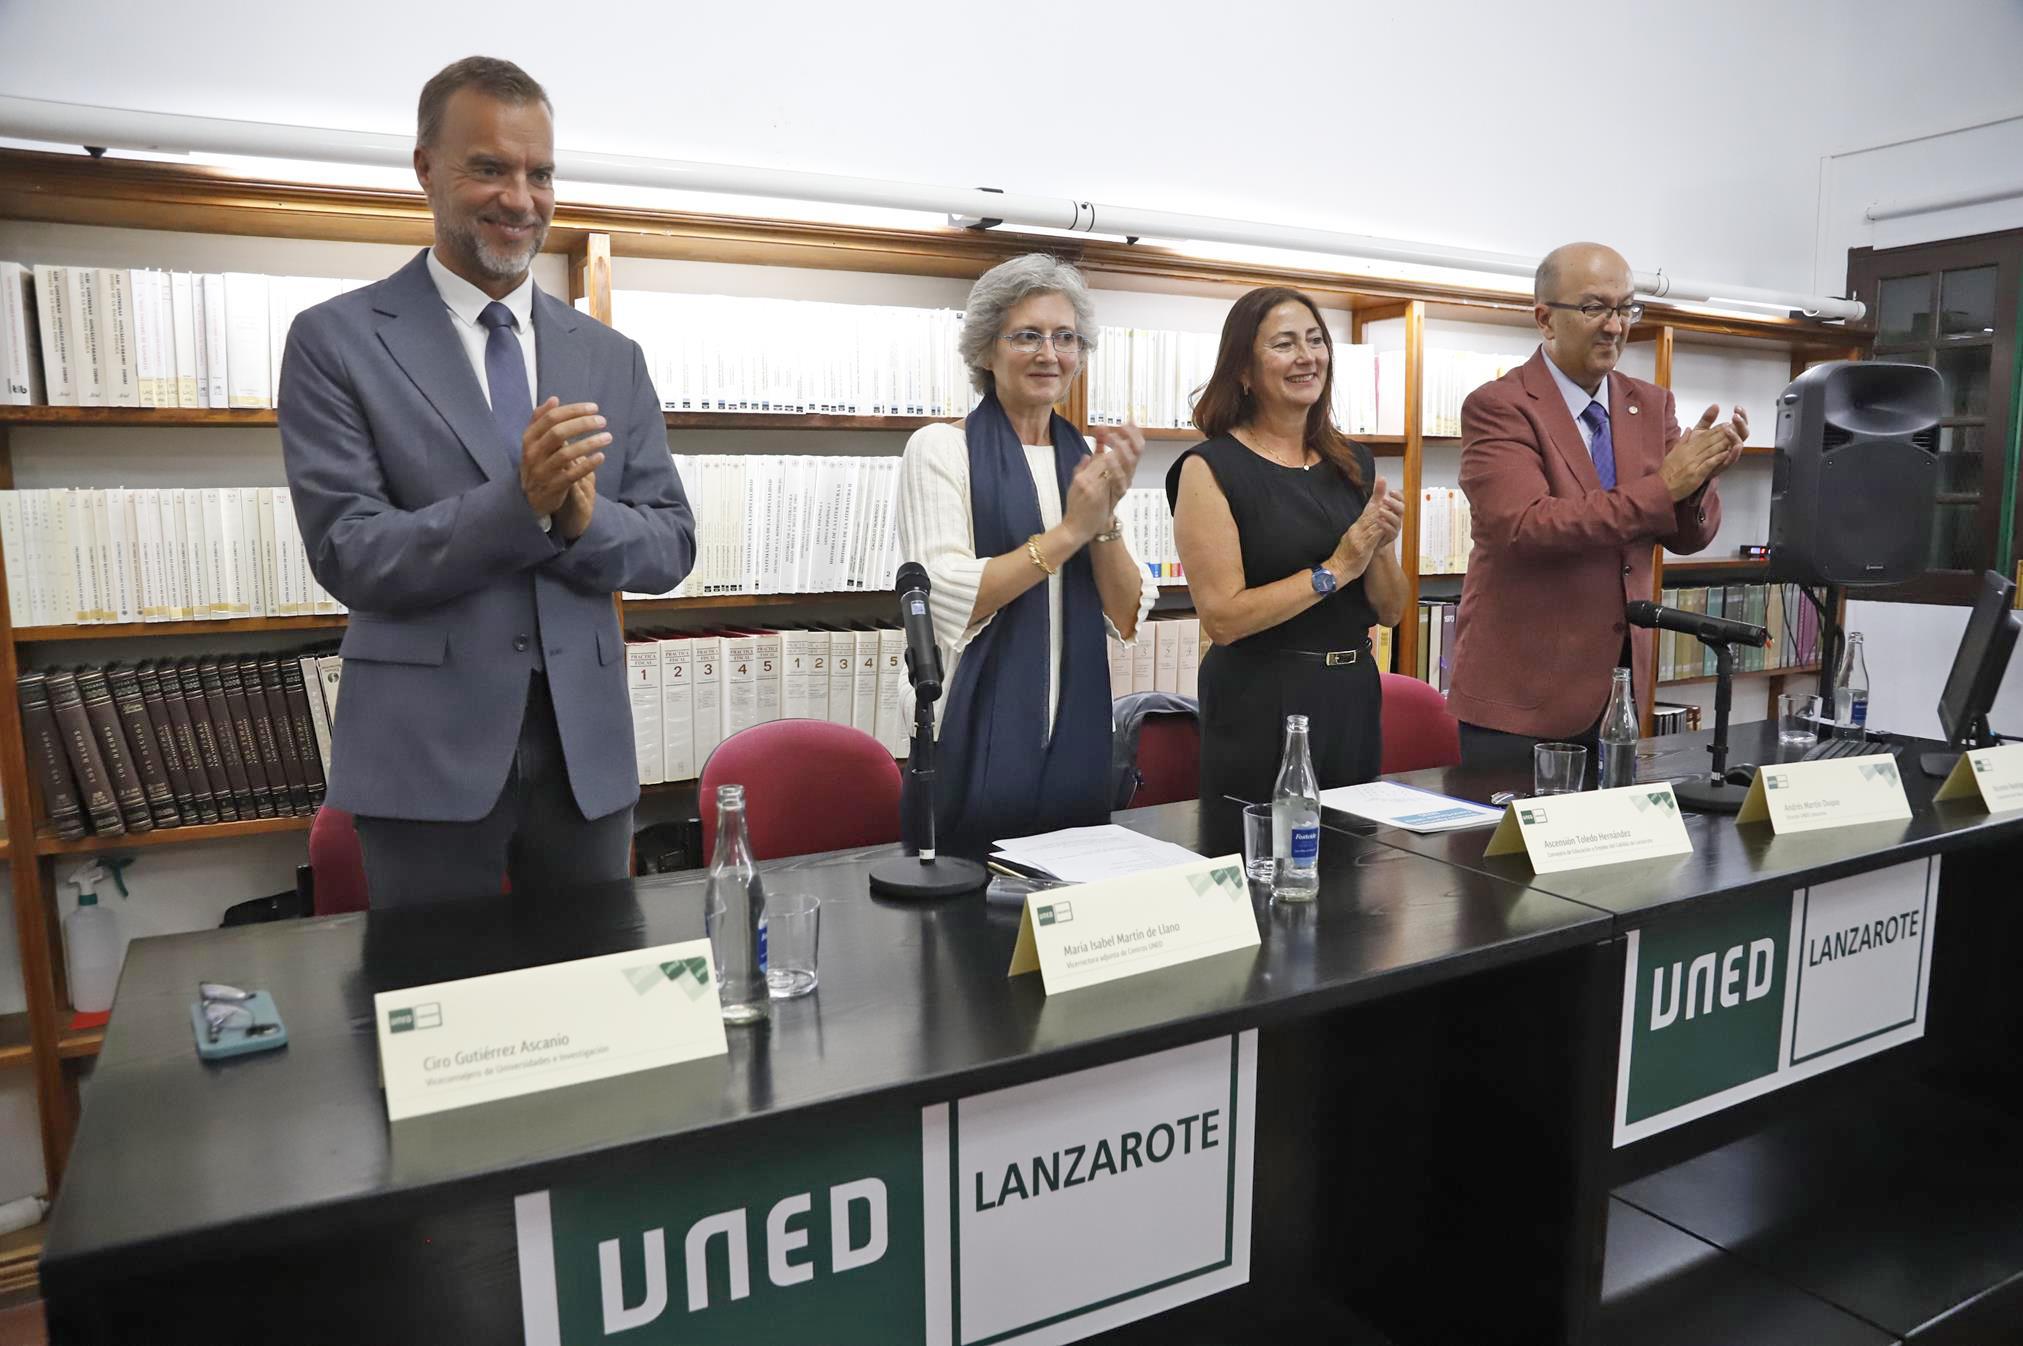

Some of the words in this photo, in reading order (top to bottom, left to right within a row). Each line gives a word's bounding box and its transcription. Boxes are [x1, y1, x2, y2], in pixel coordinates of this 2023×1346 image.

[764, 661, 772, 672] 5
[795, 658, 800, 668] 1
[815, 658, 823, 668] 2
[840, 659, 848, 669] 3
[864, 658, 873, 668] 4
[890, 657, 898, 666] 5
[641, 670, 646, 680] 1
[674, 666, 682, 677] 2
[704, 664, 712, 675] 3
[738, 664, 747, 675] 4
[1576, 834, 1598, 844] Toledo
[1090, 936, 1115, 950] Isabel
[1146, 927, 1157, 938] de
[1158, 922, 1181, 935] Llano
[1650, 938, 1775, 1031] UNED
[1809, 910, 1919, 968] LANZAROTE
[424, 1056, 450, 1071] Ciro
[455, 1045, 515, 1065] Gutiérrez
[521, 1033, 570, 1053] Ascanio
[484, 1065, 494, 1075] de
[496, 1055, 551, 1074] Universidades
[599, 1177, 888, 1335] UNED
[974, 1109, 1221, 1212] LANZAROTE
